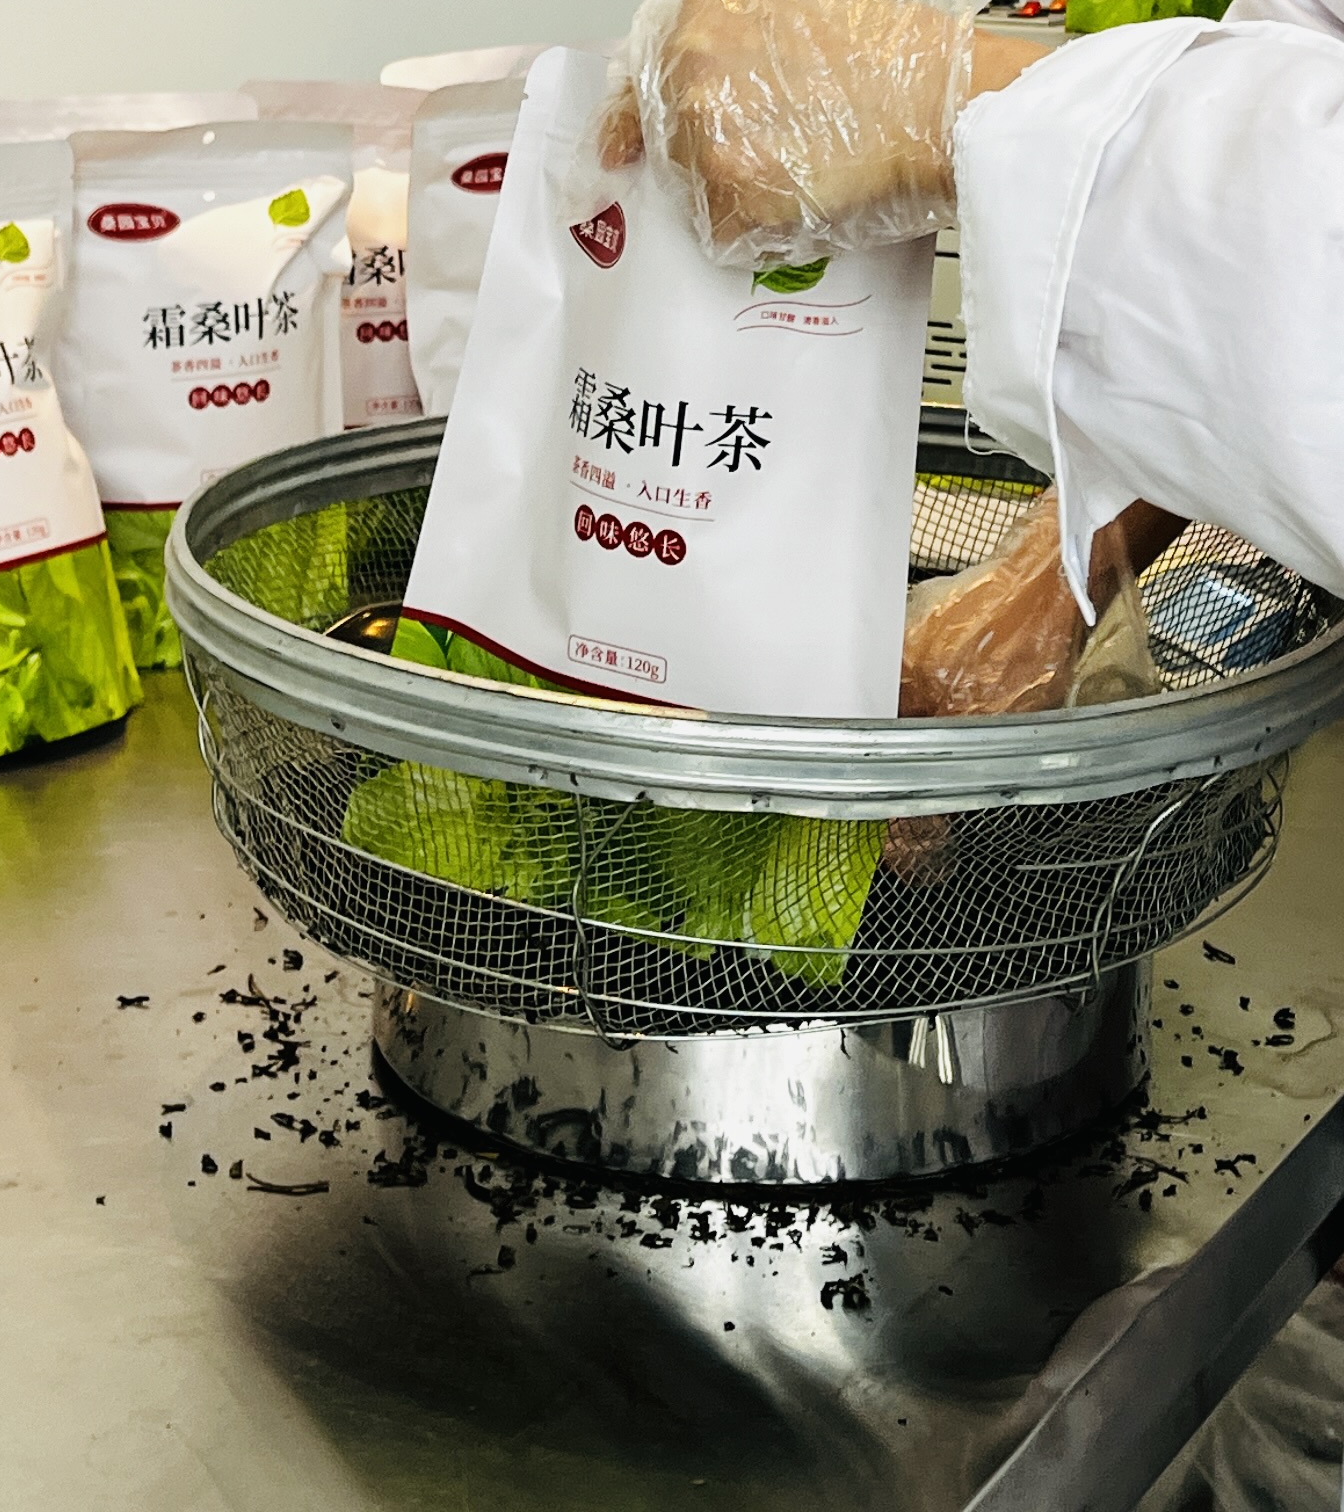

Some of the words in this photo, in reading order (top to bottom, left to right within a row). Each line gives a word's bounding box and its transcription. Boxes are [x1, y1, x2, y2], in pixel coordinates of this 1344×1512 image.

[143, 291, 298, 350] 霜桑叶茶
[569, 367, 774, 473] 霜桑叶茶
[577, 508, 682, 563] 回味悠长
[574, 640, 660, 680] 净含量:120g
